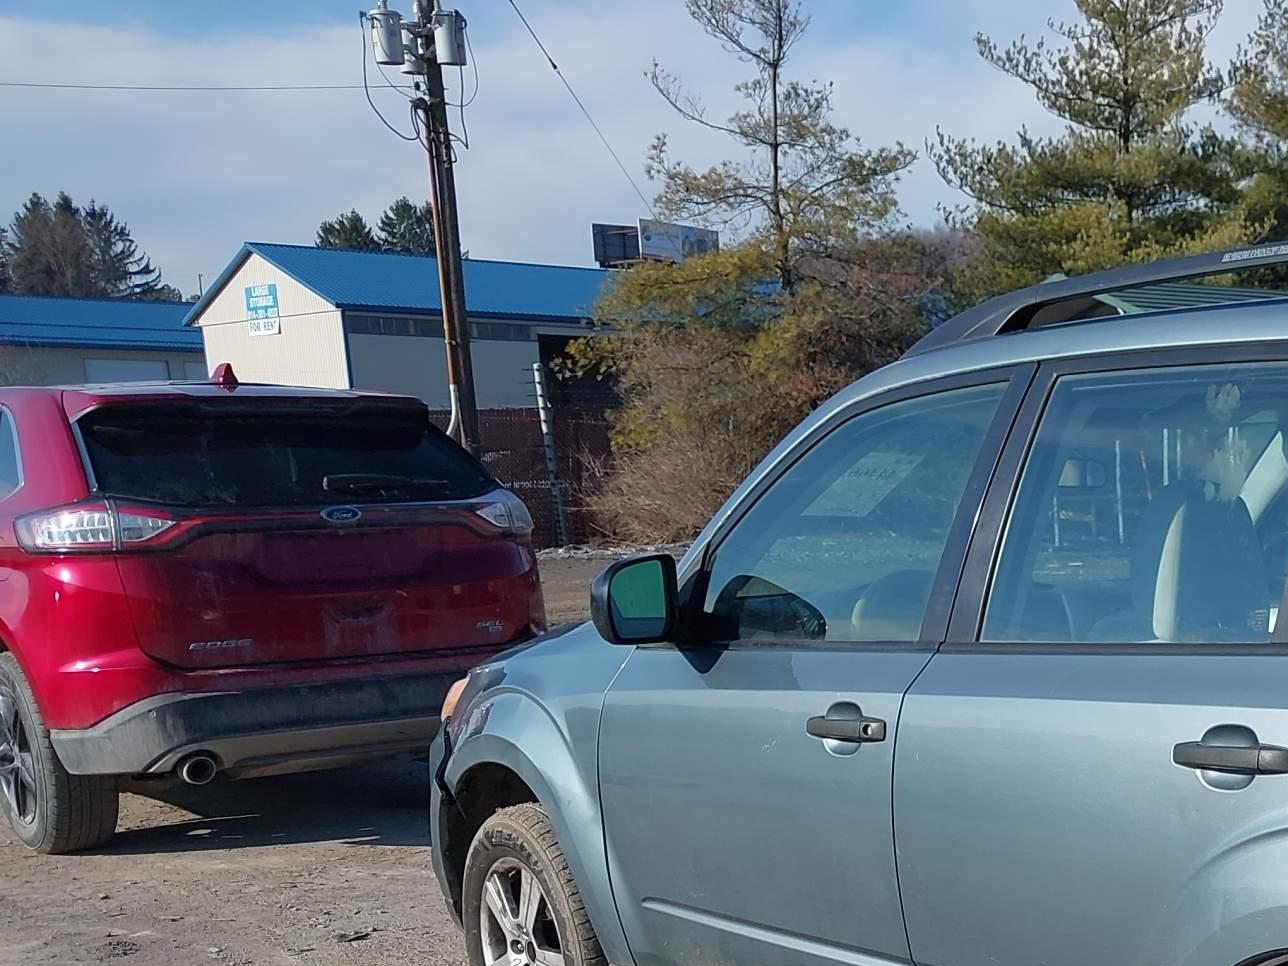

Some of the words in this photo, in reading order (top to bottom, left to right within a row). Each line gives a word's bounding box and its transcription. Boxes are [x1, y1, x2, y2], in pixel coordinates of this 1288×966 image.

[249, 295, 275, 308] STORAGE
[249, 321, 262, 333] FOR
[263, 319, 278, 331] RENT
[188, 638, 256, 651] EDGE
